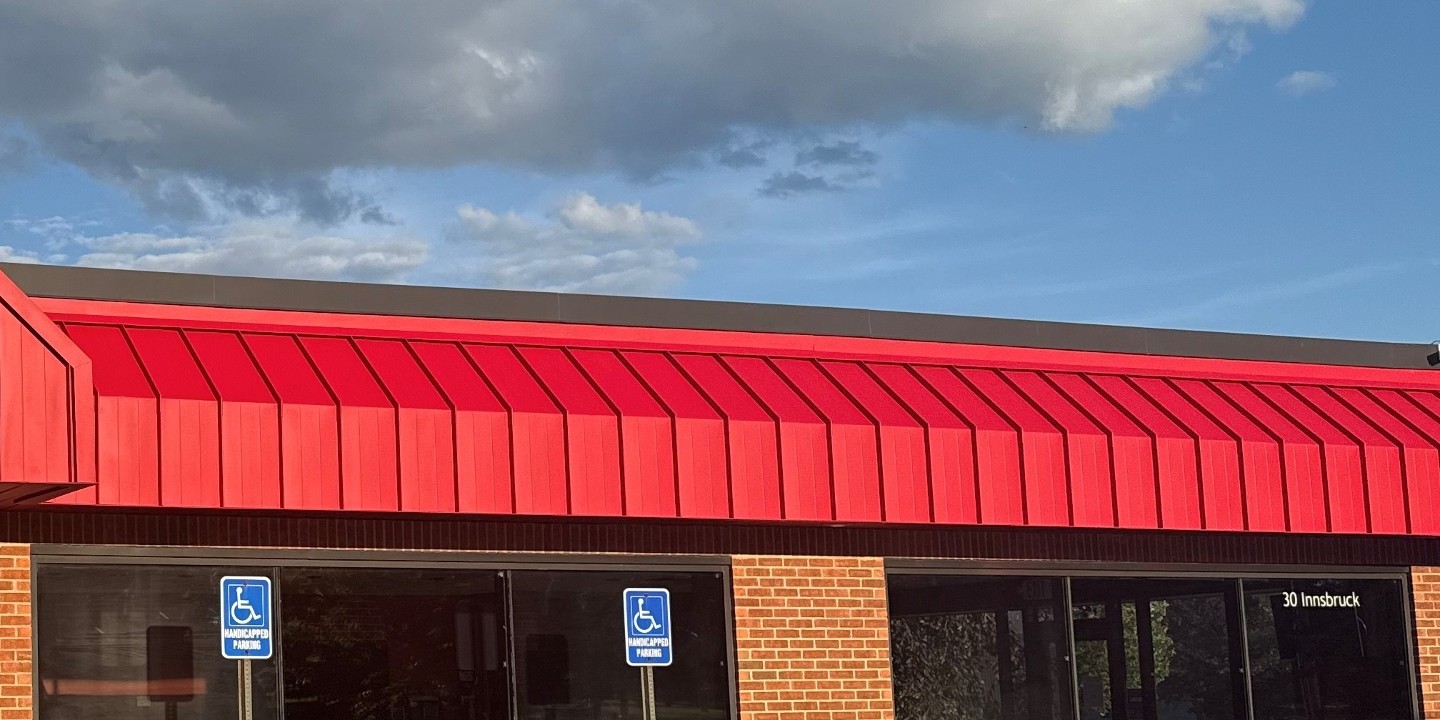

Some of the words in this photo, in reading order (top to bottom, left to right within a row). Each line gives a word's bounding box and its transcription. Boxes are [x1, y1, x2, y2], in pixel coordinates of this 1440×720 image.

[1282, 591, 1298, 607] 30
[1301, 591, 1361, 607] Innsbruck
[224, 628, 269, 639] HANDICAPPED
[233, 639, 262, 650] PARKING
[628, 637, 669, 647] HANDICAPPED
[636, 648, 662, 658] PARKING
